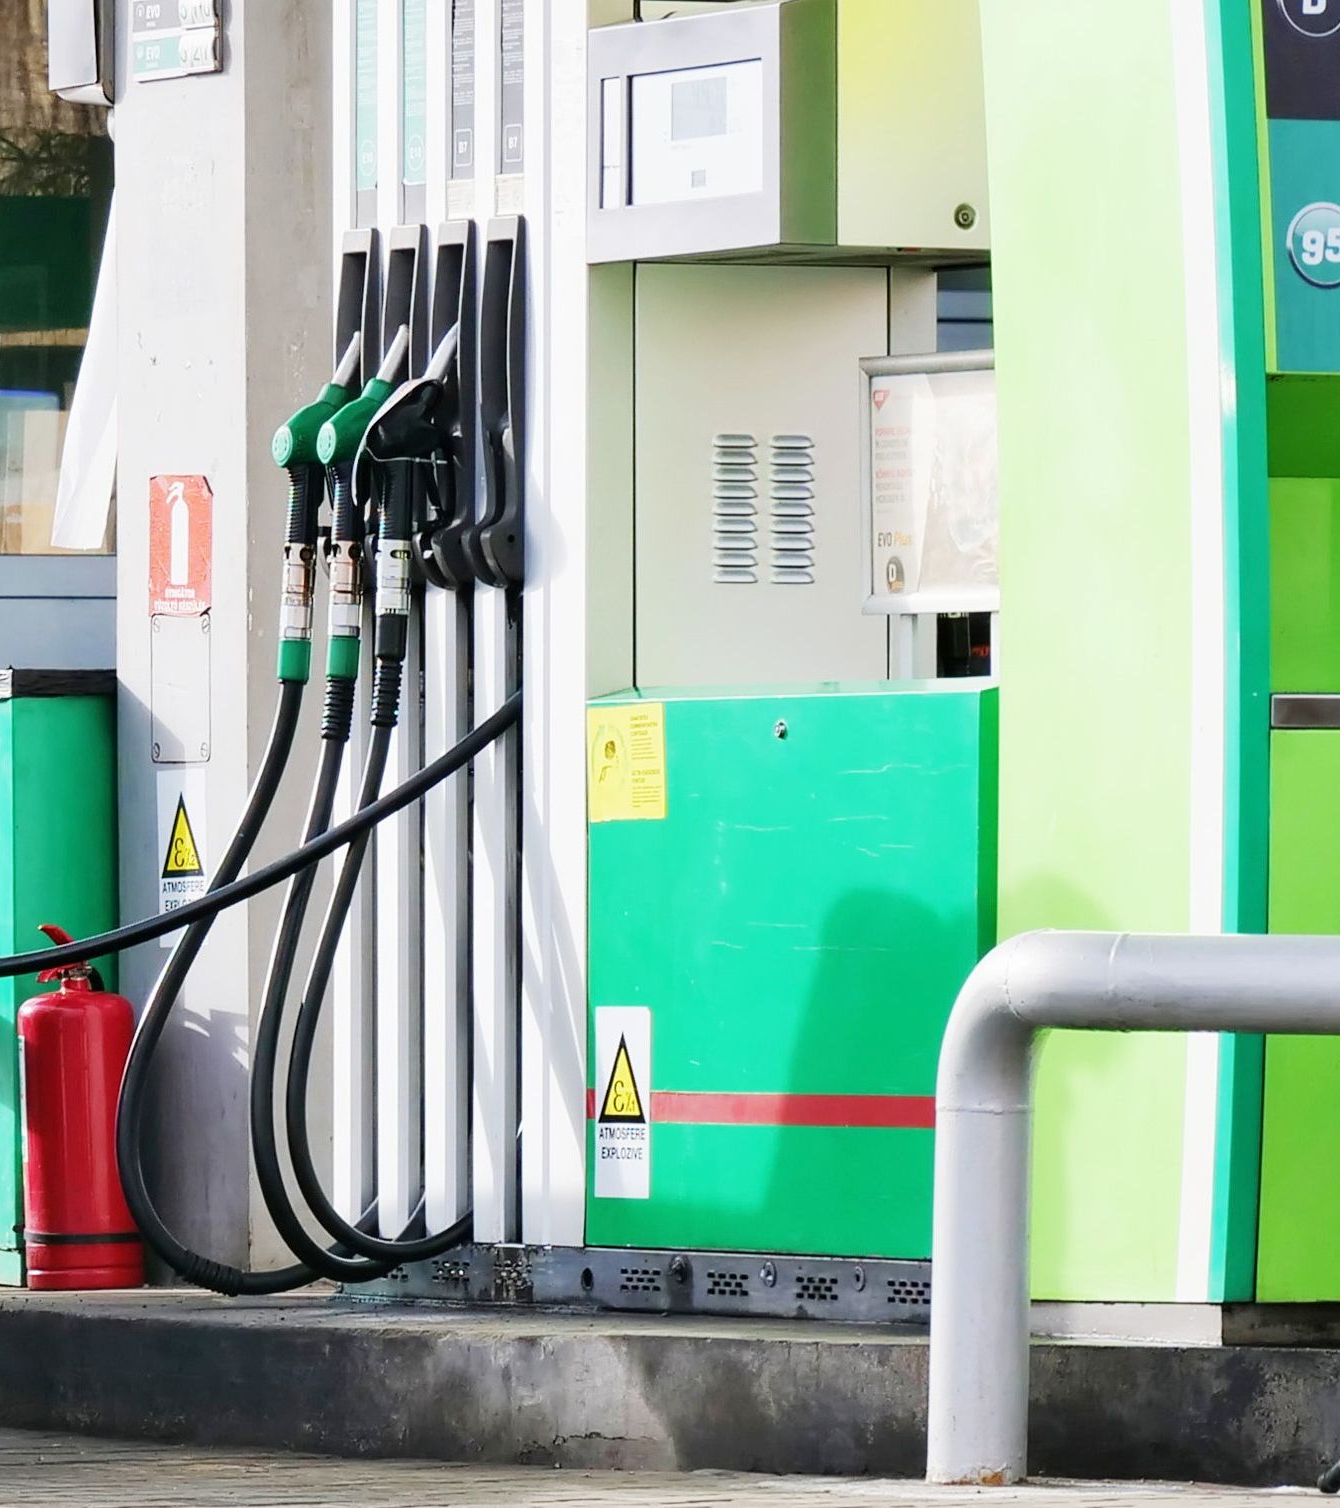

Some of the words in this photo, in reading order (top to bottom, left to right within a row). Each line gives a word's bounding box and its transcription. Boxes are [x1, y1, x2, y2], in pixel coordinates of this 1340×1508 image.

[1301, 227, 1340, 266] 95
[598, 1127, 645, 1140] ATMOSFERE
[601, 1147, 643, 1160] EXPLOZIVE
